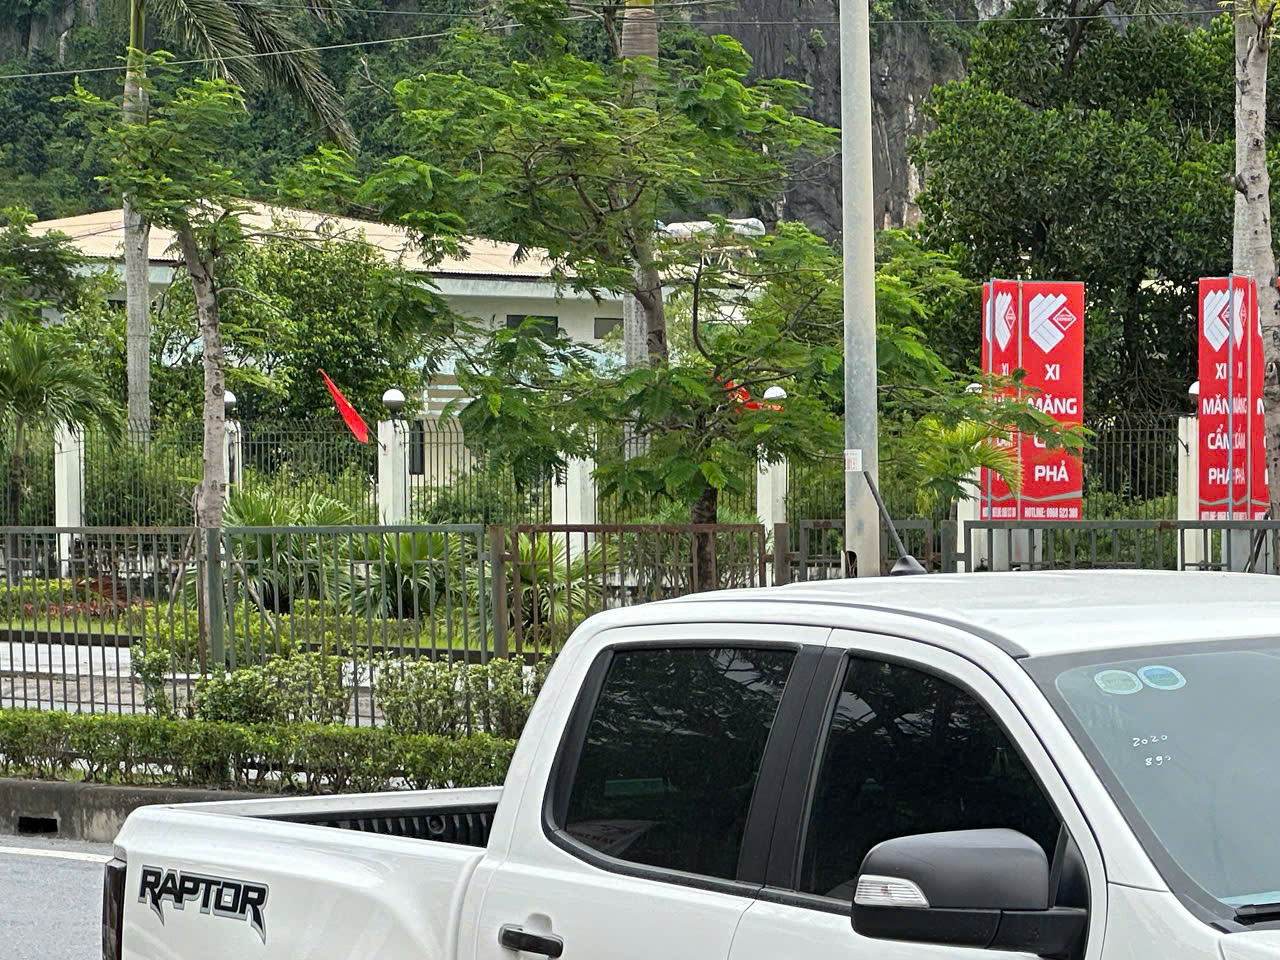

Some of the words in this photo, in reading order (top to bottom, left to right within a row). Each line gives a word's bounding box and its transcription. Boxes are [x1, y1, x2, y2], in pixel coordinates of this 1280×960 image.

[1044, 363, 1060, 381] XI
[1215, 362, 1227, 380] XI
[1202, 394, 1230, 415] MĂN
[1035, 460, 1070, 482] PHẢ
[1132, 734, 1168, 747] 2020
[138, 864, 269, 945] RAPTOR
